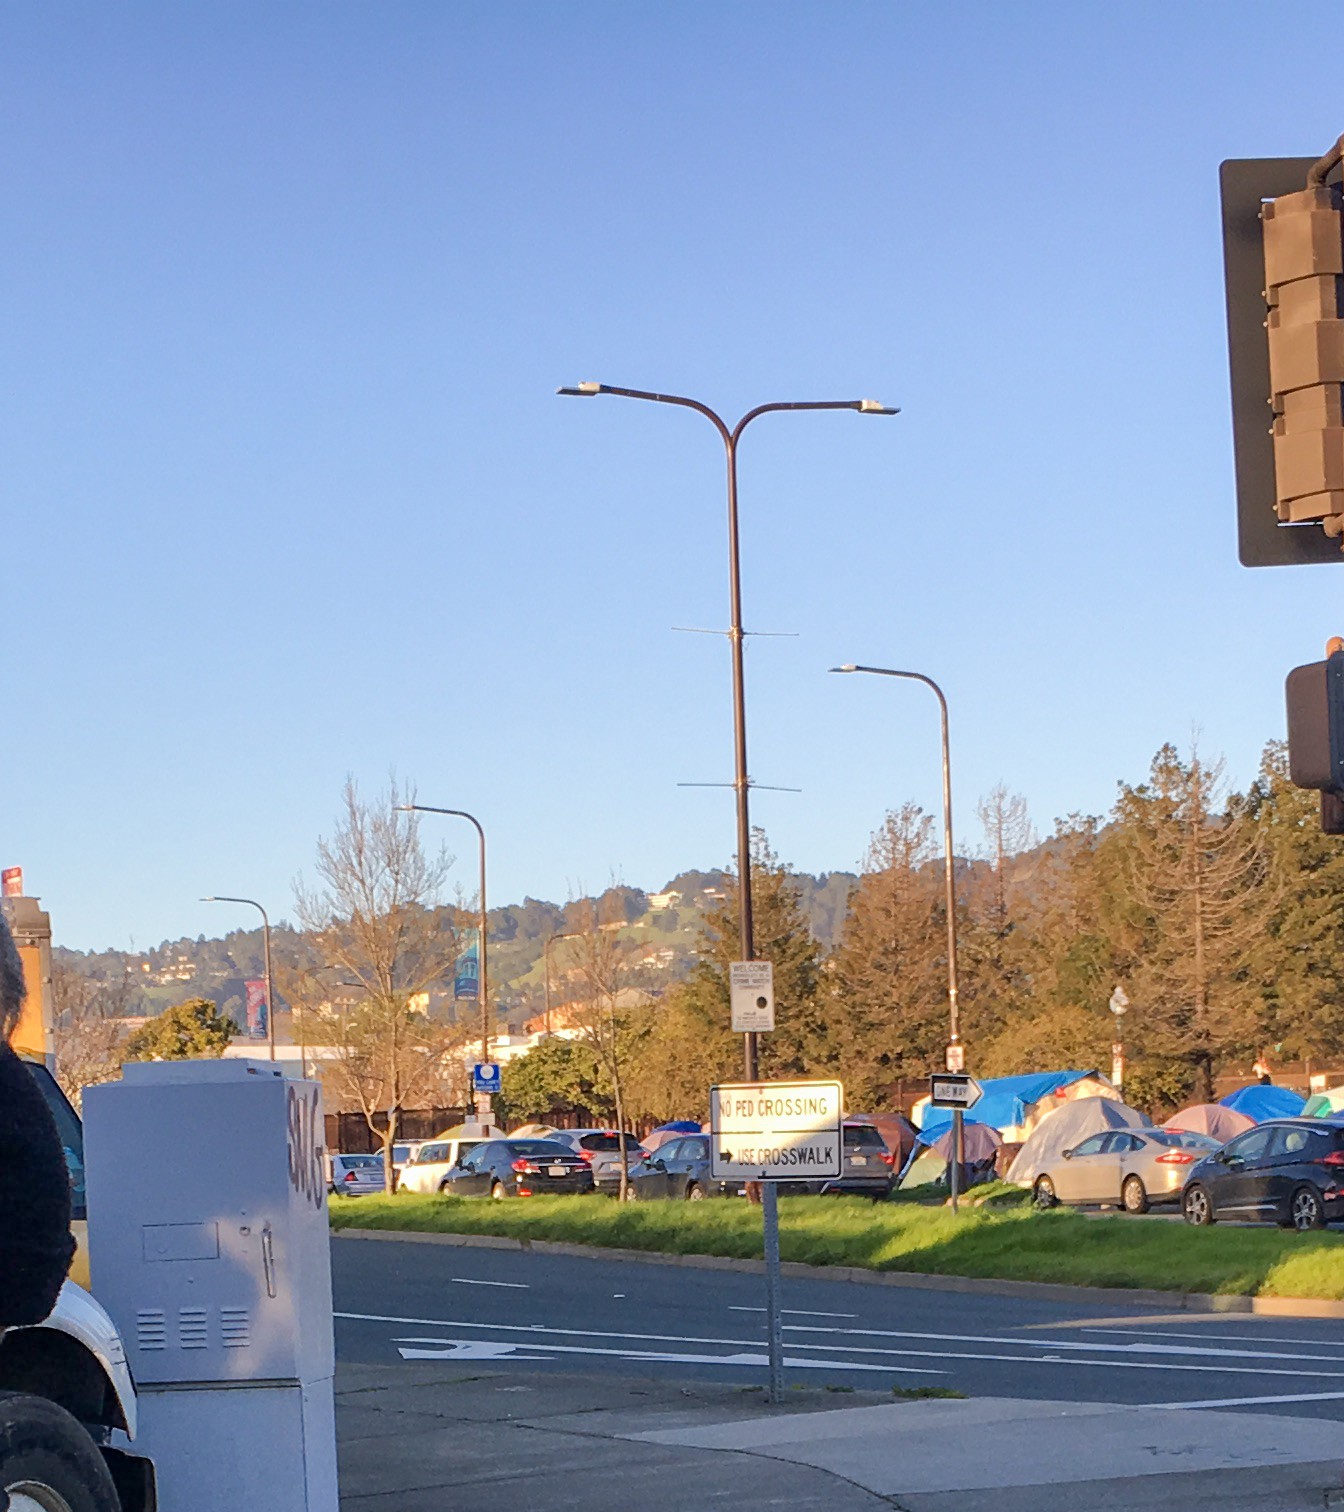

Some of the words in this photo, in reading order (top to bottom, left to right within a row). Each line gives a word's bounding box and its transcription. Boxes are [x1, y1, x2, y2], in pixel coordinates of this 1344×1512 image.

[937, 1086, 950, 1097] ONE
[952, 1086, 967, 1096] WAY
[720, 1101, 731, 1117] NO
[736, 1100, 754, 1117] PED
[758, 1098, 827, 1116] CROSSING
[738, 1149, 755, 1165] USE
[758, 1147, 833, 1165] CROSSWALK
